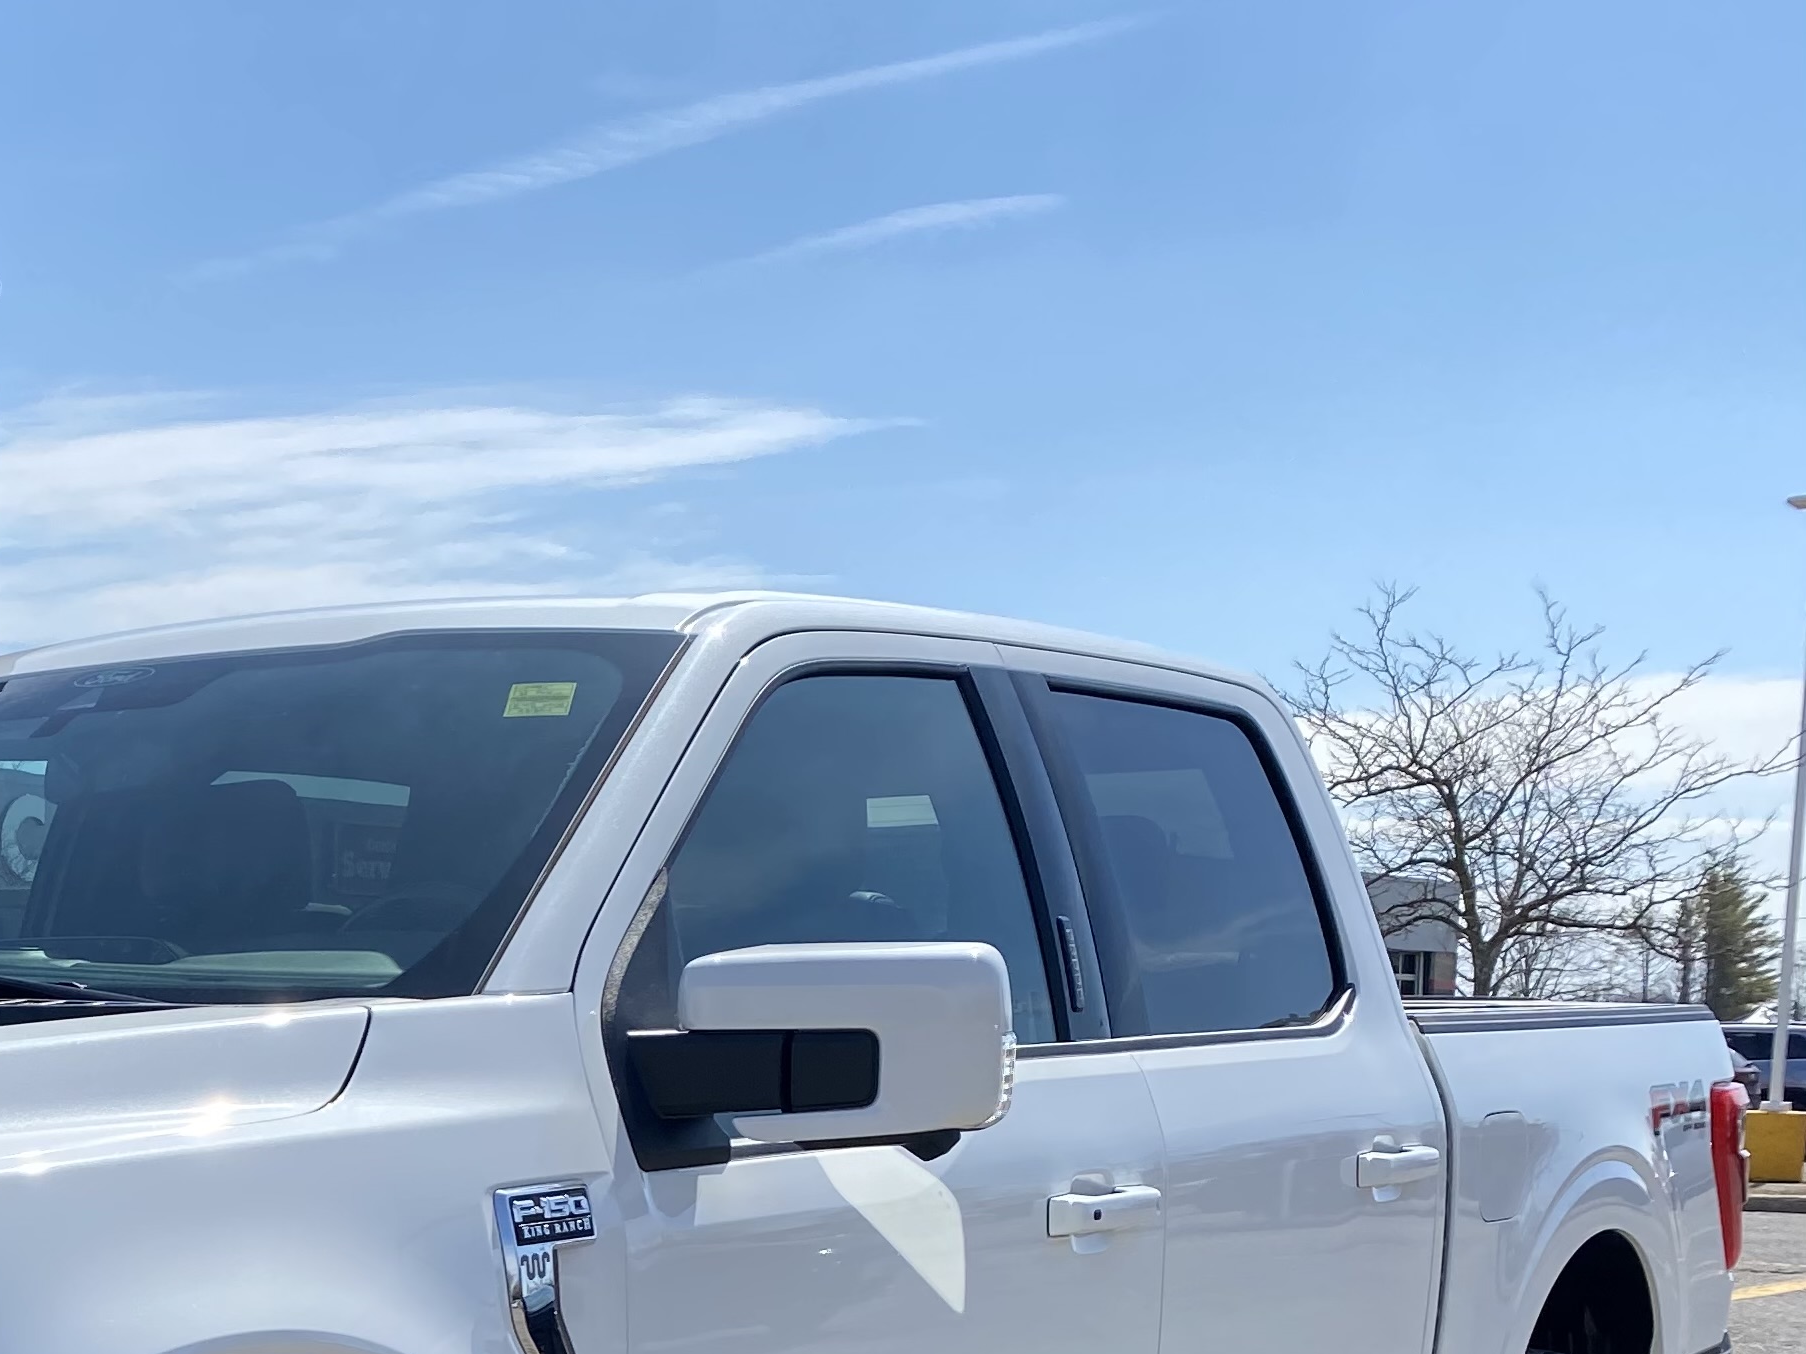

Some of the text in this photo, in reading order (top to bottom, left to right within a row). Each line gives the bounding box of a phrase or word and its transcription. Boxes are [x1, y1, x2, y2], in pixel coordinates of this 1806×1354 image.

[512, 1194, 591, 1223] F-150
[523, 1217, 592, 1239] KING RANCH
